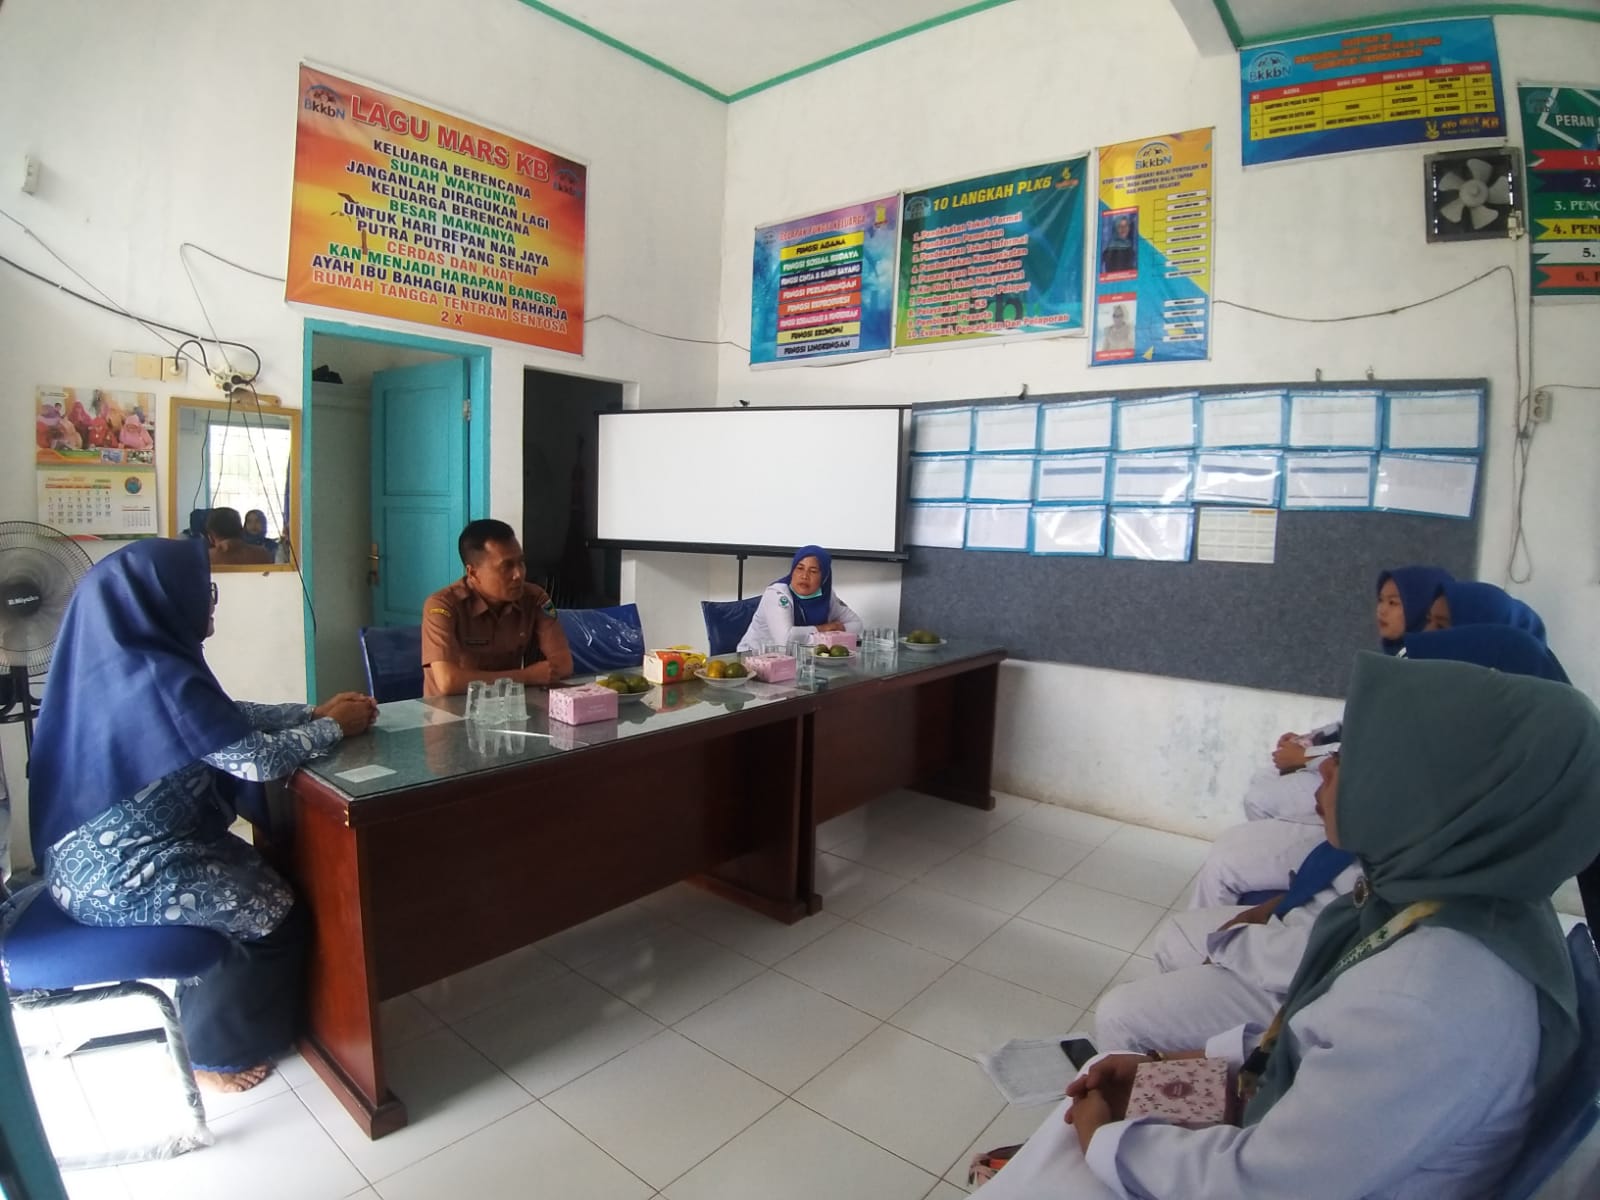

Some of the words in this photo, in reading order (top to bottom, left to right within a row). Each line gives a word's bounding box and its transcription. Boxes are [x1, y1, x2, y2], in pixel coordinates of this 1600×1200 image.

[1250, 66, 1291, 81] BkkbN
[304, 98, 346, 120] BkkbN
[1555, 115, 1594, 127] PERAN
[351, 95, 429, 140] LAGU
[438, 124, 508, 167] MARS
[516, 152, 550, 182] KB
[373, 140, 448, 172] KELUARGA
[453, 164, 531, 199] BERENCANA
[390, 160, 440, 182] SUDAH
[445, 175, 516, 206] WAKTUNYA
[1135, 155, 1172, 169] BkkbN
[1584, 177, 1596, 188] 2.
[346, 161, 436, 194] JANGANLAH
[442, 188, 517, 219] DIRAGUKAN
[522, 212, 549, 229] LAGI
[372, 182, 447, 212] KELUARGA
[452, 206, 530, 236] BERENCANA
[933, 196, 949, 211] 10
[952, 186, 1014, 208] LANGKAH
[1018, 176, 1053, 194] PLKB
[1554, 200, 1566, 210] 3.
[344, 204, 396, 226] UNTUK
[402, 218, 436, 237] HARI
[441, 228, 486, 249] DEPAN
[490, 240, 516, 256] NAN
[520, 250, 549, 266] JAYA
[390, 200, 437, 222] BESAR
[442, 216, 515, 244] MAKNANYA
[1553, 224, 1566, 234] 4.
[357, 221, 408, 243] PUTRA
[414, 234, 456, 254] PUTRI
[460, 247, 494, 265] YANG
[500, 258, 538, 275] SEHAT
[387, 242, 446, 265] CERDAS
[450, 257, 477, 273] DAN
[482, 265, 514, 282] KUAT
[1582, 248, 1596, 258] 5.
[312, 256, 354, 274] AYAH
[360, 266, 387, 280] IBU
[392, 272, 456, 294] BAHAGIA
[462, 288, 507, 306] RUKUN
[512, 300, 568, 320] RAHARJA
[329, 243, 362, 260] KAN
[368, 252, 436, 276] MENJADI
[441, 268, 504, 292] HARAPAN
[509, 286, 558, 306] BANGSA
[313, 270, 374, 292] RUMAH
[380, 286, 438, 308] TANGGA
[444, 297, 508, 320] TENTRAM
[512, 314, 566, 333] SENTOSA
[441, 312, 448, 322] 2
[454, 315, 464, 326] X
